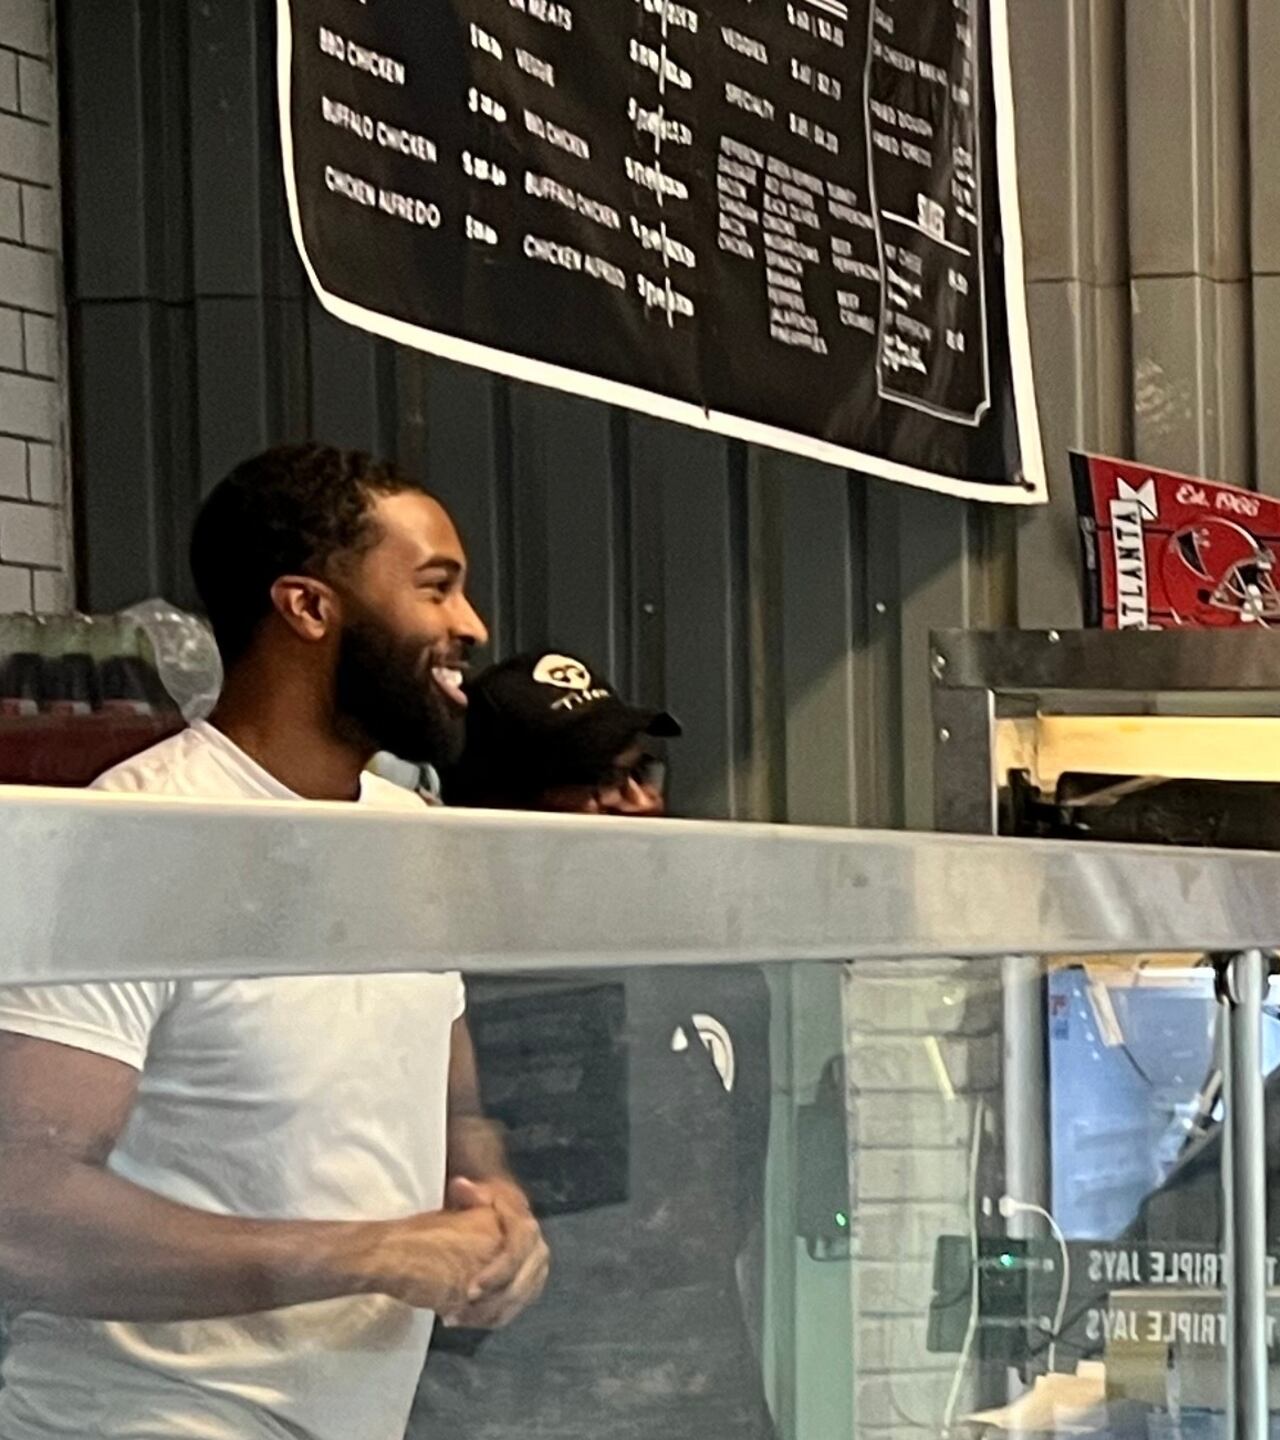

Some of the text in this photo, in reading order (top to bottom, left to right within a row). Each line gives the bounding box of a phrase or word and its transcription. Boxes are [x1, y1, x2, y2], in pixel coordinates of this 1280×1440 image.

[347, 40, 405, 85] CHICKEN
[321, 95, 437, 164] BUFFALO CHICKEN
[546, 121, 590, 160] CHICKEN
[325, 165, 441, 229] CHICKEN ALFREDO
[523, 233, 582, 271] CHICKEN
